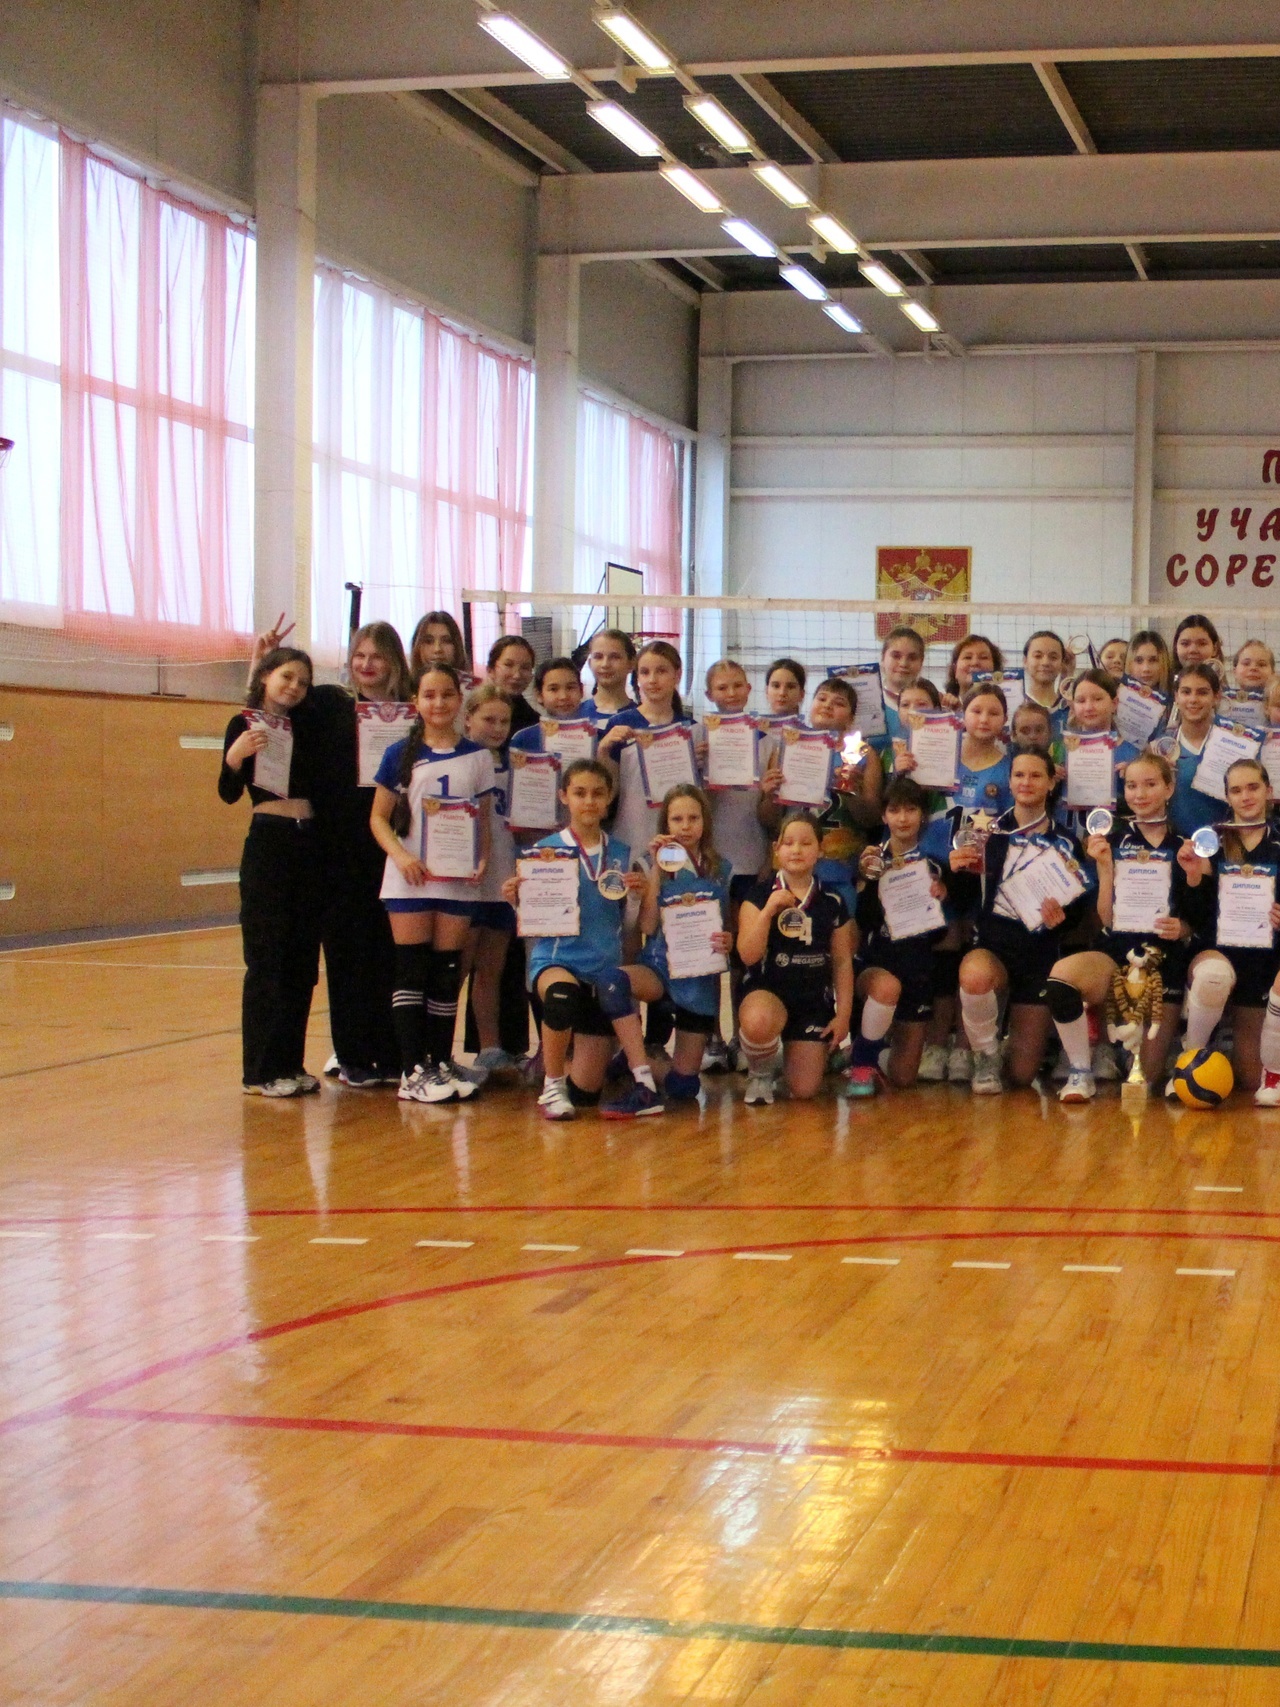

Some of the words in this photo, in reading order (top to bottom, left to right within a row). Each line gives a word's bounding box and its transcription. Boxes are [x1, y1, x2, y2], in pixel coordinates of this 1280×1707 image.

[557, 733, 584, 741] ГРАМОТА
[654, 741, 681, 750] ГРАМОТА
[437, 775, 449, 797] 1
[889, 870, 917, 884] ДИПЛОМ
[675, 910, 706, 919] ДИПЛОМ
